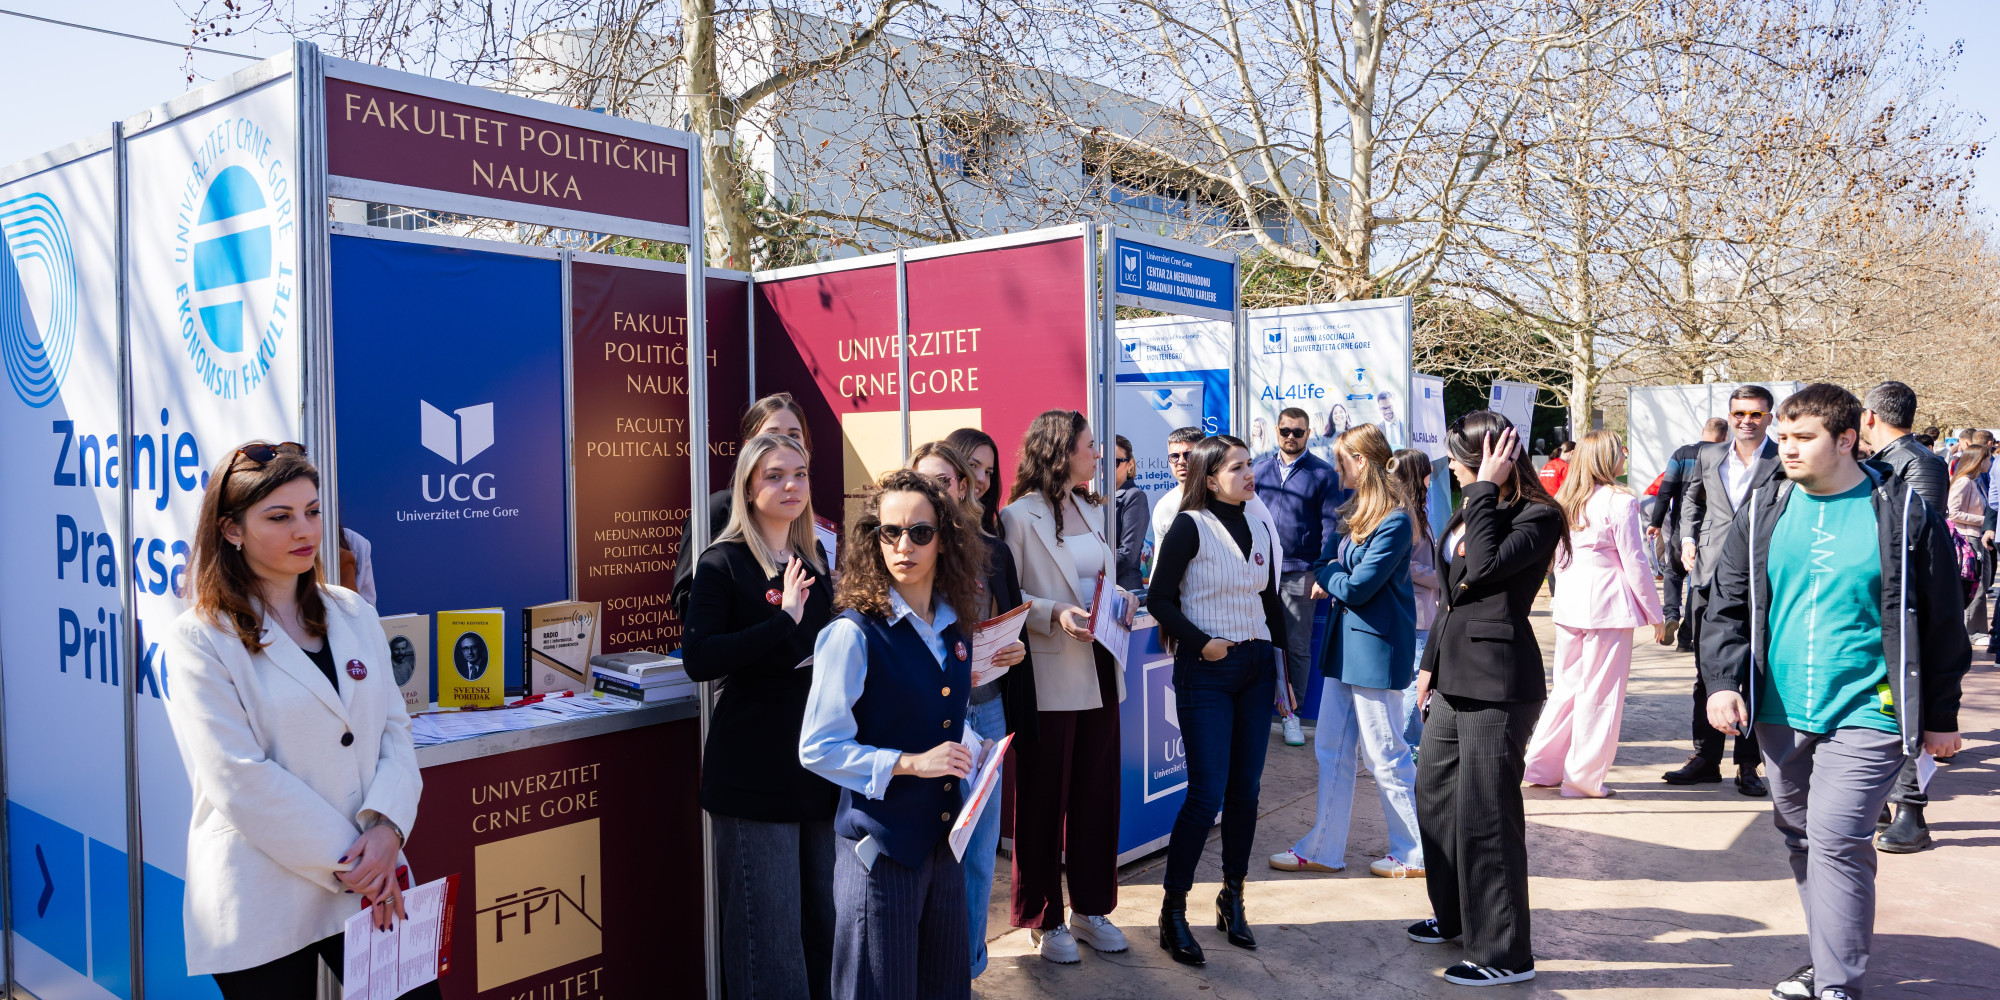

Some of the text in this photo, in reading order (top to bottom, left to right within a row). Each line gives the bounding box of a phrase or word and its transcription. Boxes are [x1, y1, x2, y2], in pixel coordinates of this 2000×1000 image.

[345, 92, 677, 177] FAKULTET POLITIČKIH
[472, 159, 582, 201] NAUKA
[175, 117, 293, 263] UNIVERZITET CRNE GORE
[1146, 251, 1193, 269] Univerzitet Crne Gore
[1125, 273, 1136, 282] UCG
[1146, 265, 1166, 279] CENTAR
[1166, 269, 1173, 280] ZA
[1147, 280, 1173, 294] SARADNJU
[1176, 287, 1195, 299] RAZVOJ
[1195, 289, 1217, 303] KARIJERE
[175, 261, 293, 400] EKONOMSKI FAKULTET
[614, 311, 709, 336] FAKULT
[838, 328, 982, 362] UNIVERZITET
[1318, 332, 1355, 341] ASOCIJACIJA
[605, 341, 717, 367] POLITIČH
[1293, 341, 1371, 352] UNIVERZITETA CRNE GORE
[627, 374, 689, 395] NAUK
[839, 367, 979, 398] CRNE GORE
[1261, 383, 1325, 400] AL4Life
[616, 417, 685, 433] FACULTY
[587, 441, 671, 457] POLITICAL
[1146, 471, 1171, 480] ideje,
[422, 472, 496, 503] UCG
[396, 506, 519, 522] Univerzitet Crne Gore
[604, 544, 664, 559] POLITICAL
[621, 609, 679, 627] I SOCIJAL
[543, 631, 559, 639] RADIO
[609, 630, 653, 645] SOCIAL
[1154, 763, 1181, 780] Univerzitet
[472, 763, 600, 805] UNIVERZITET
[472, 790, 598, 833] CRNE GORE
[495, 874, 602, 943] FPN
